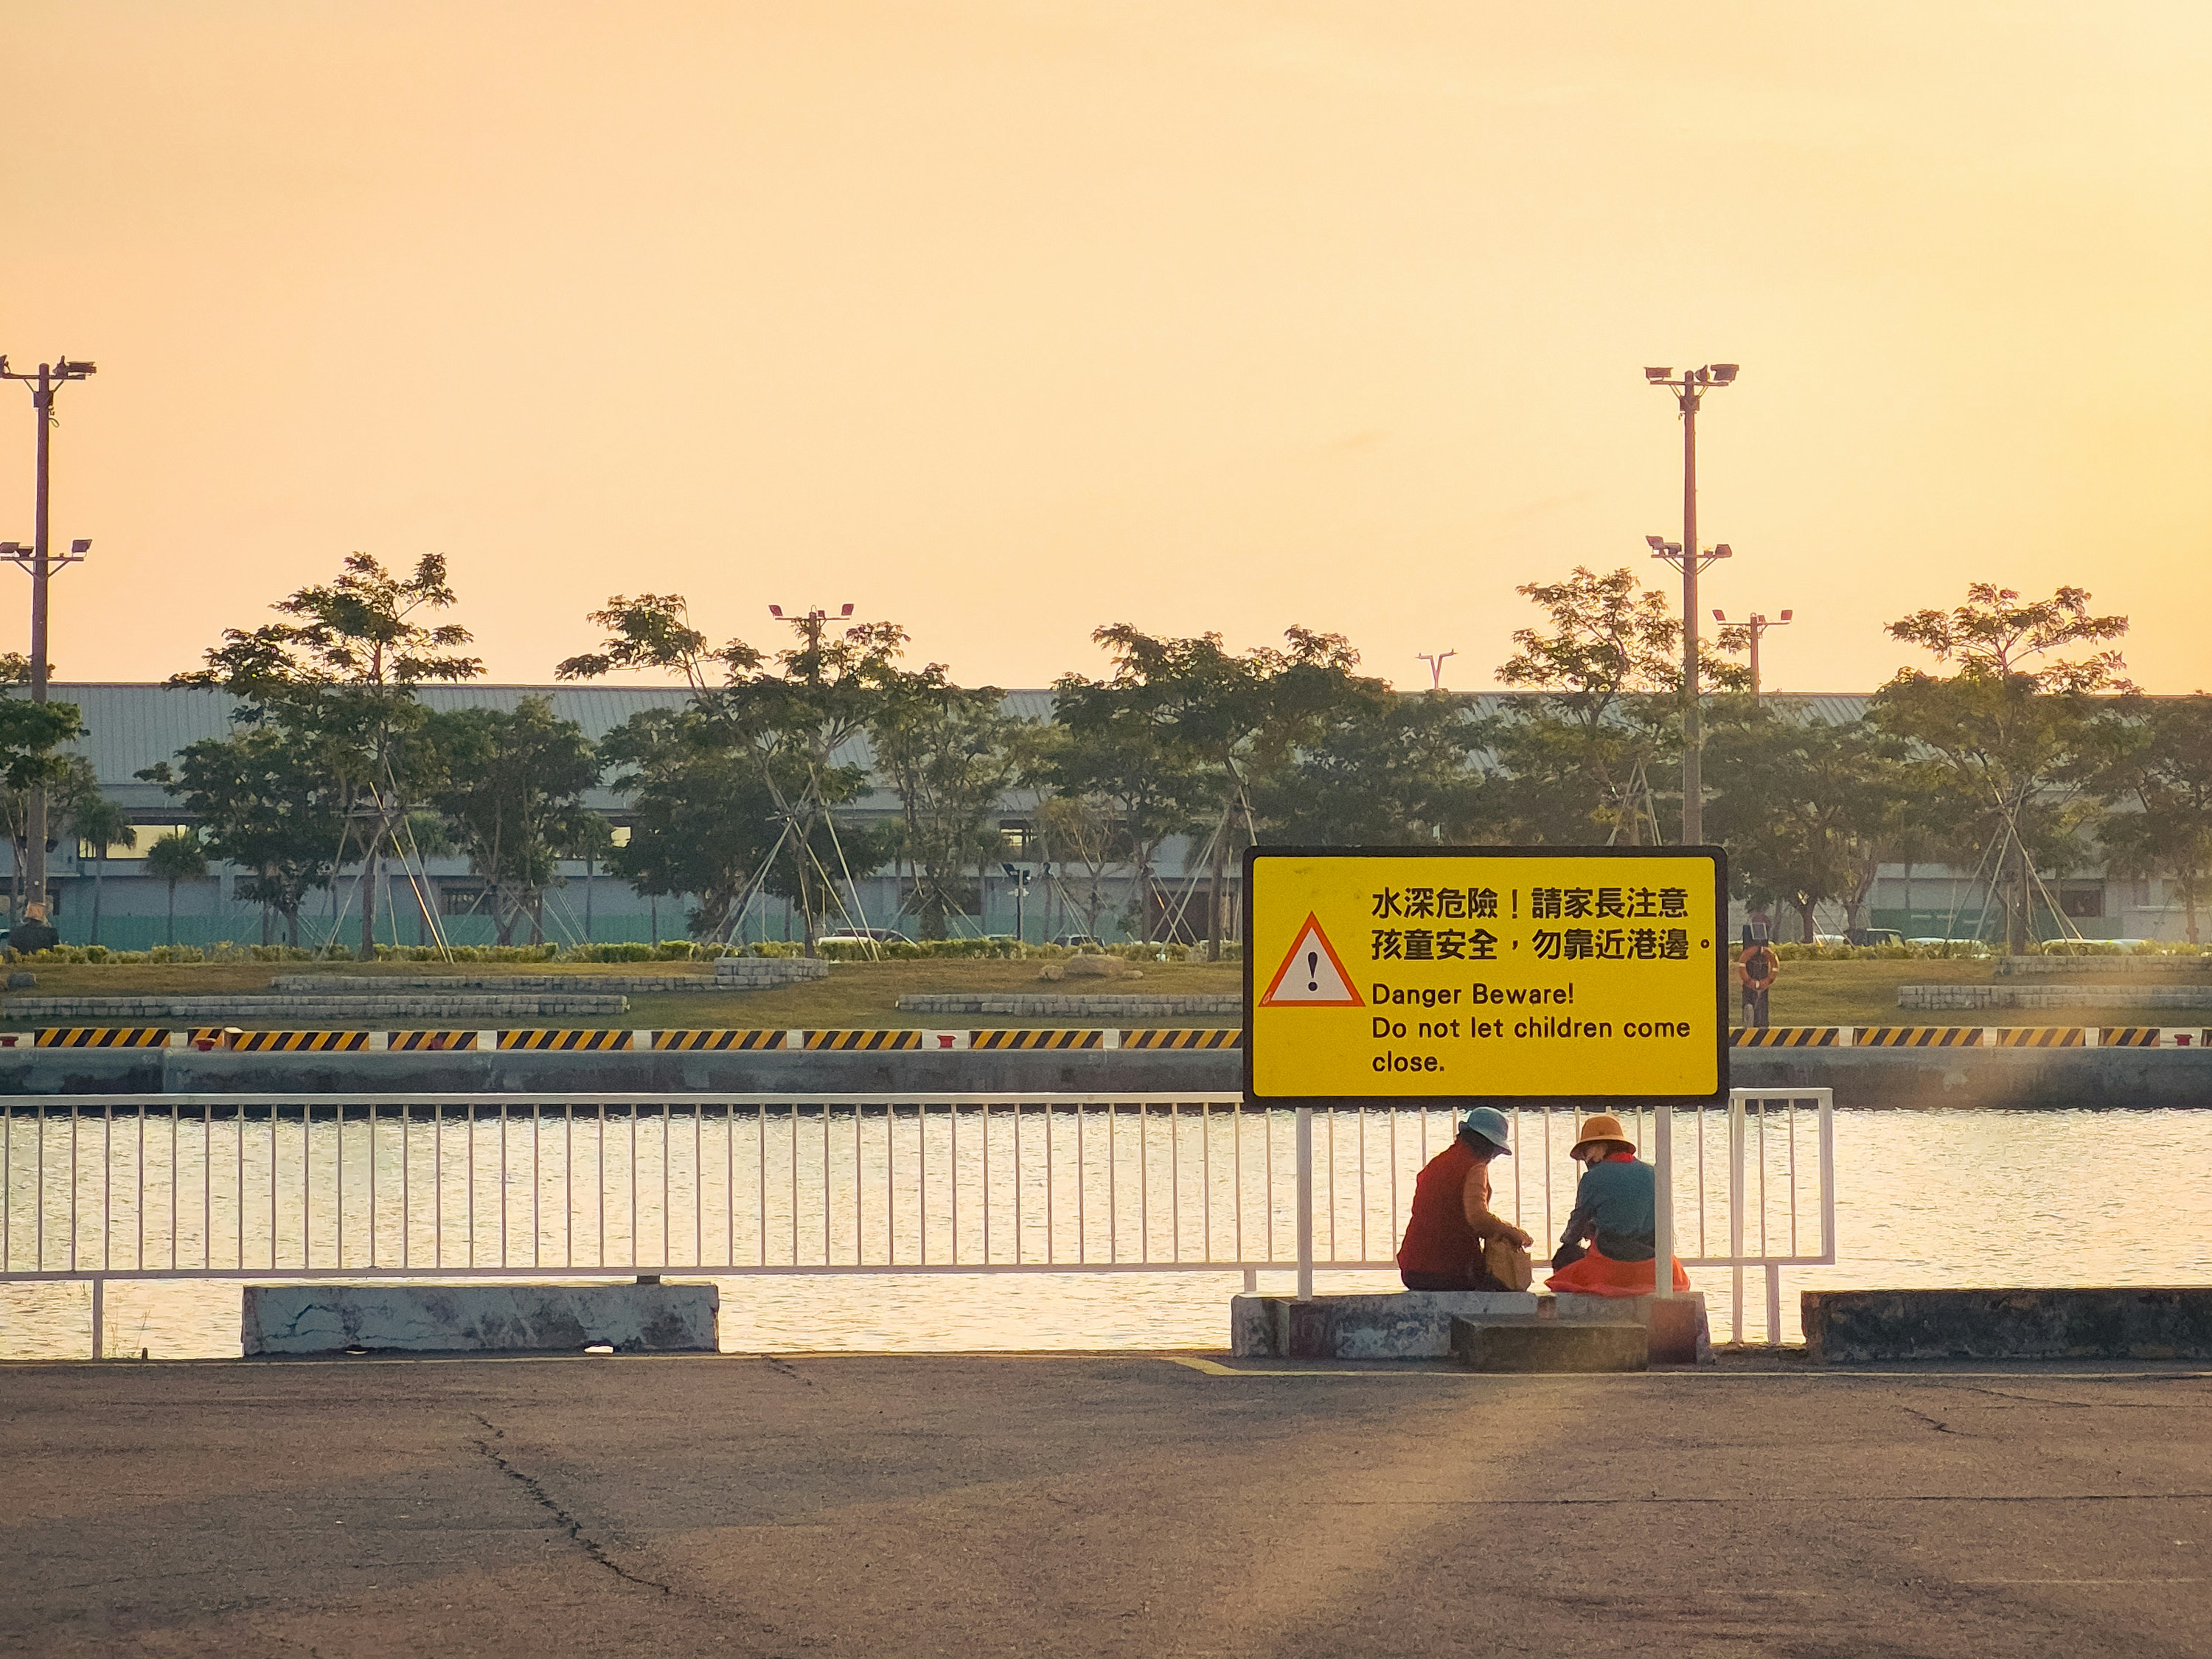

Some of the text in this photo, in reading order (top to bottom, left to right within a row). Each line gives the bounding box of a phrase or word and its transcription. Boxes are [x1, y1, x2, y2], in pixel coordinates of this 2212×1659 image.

[1372, 982, 1574, 1008] Danger Beware!
[1372, 1015, 1691, 1038] Do not let children come
[1371, 1050, 1445, 1072] close.
